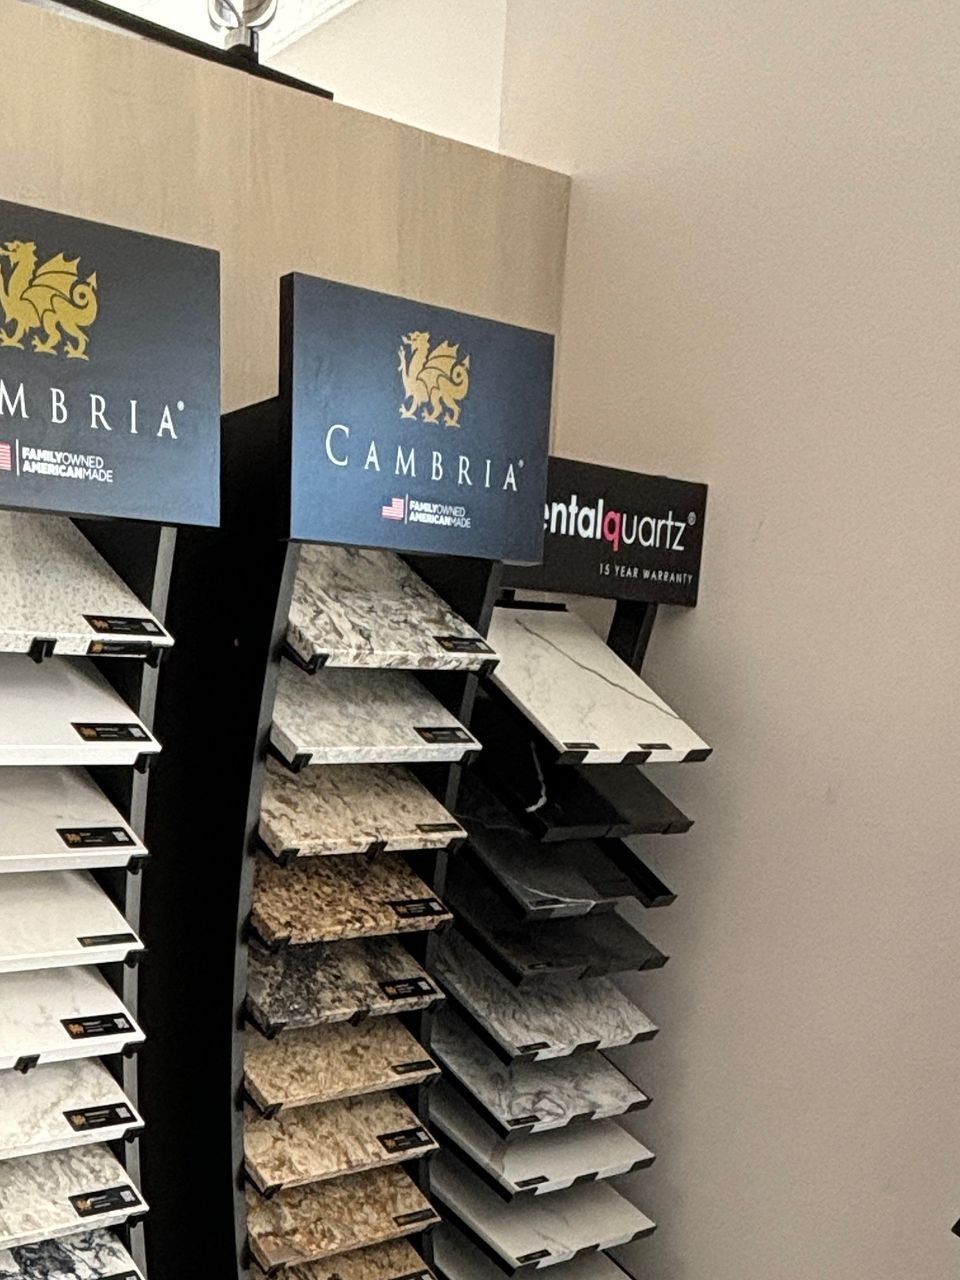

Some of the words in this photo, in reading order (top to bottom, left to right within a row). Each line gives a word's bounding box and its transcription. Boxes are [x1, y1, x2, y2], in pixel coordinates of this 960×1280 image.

[599, 563, 610, 576] 15
[614, 565, 639, 579] YEAR
[643, 569, 694, 585] WARRANTY
